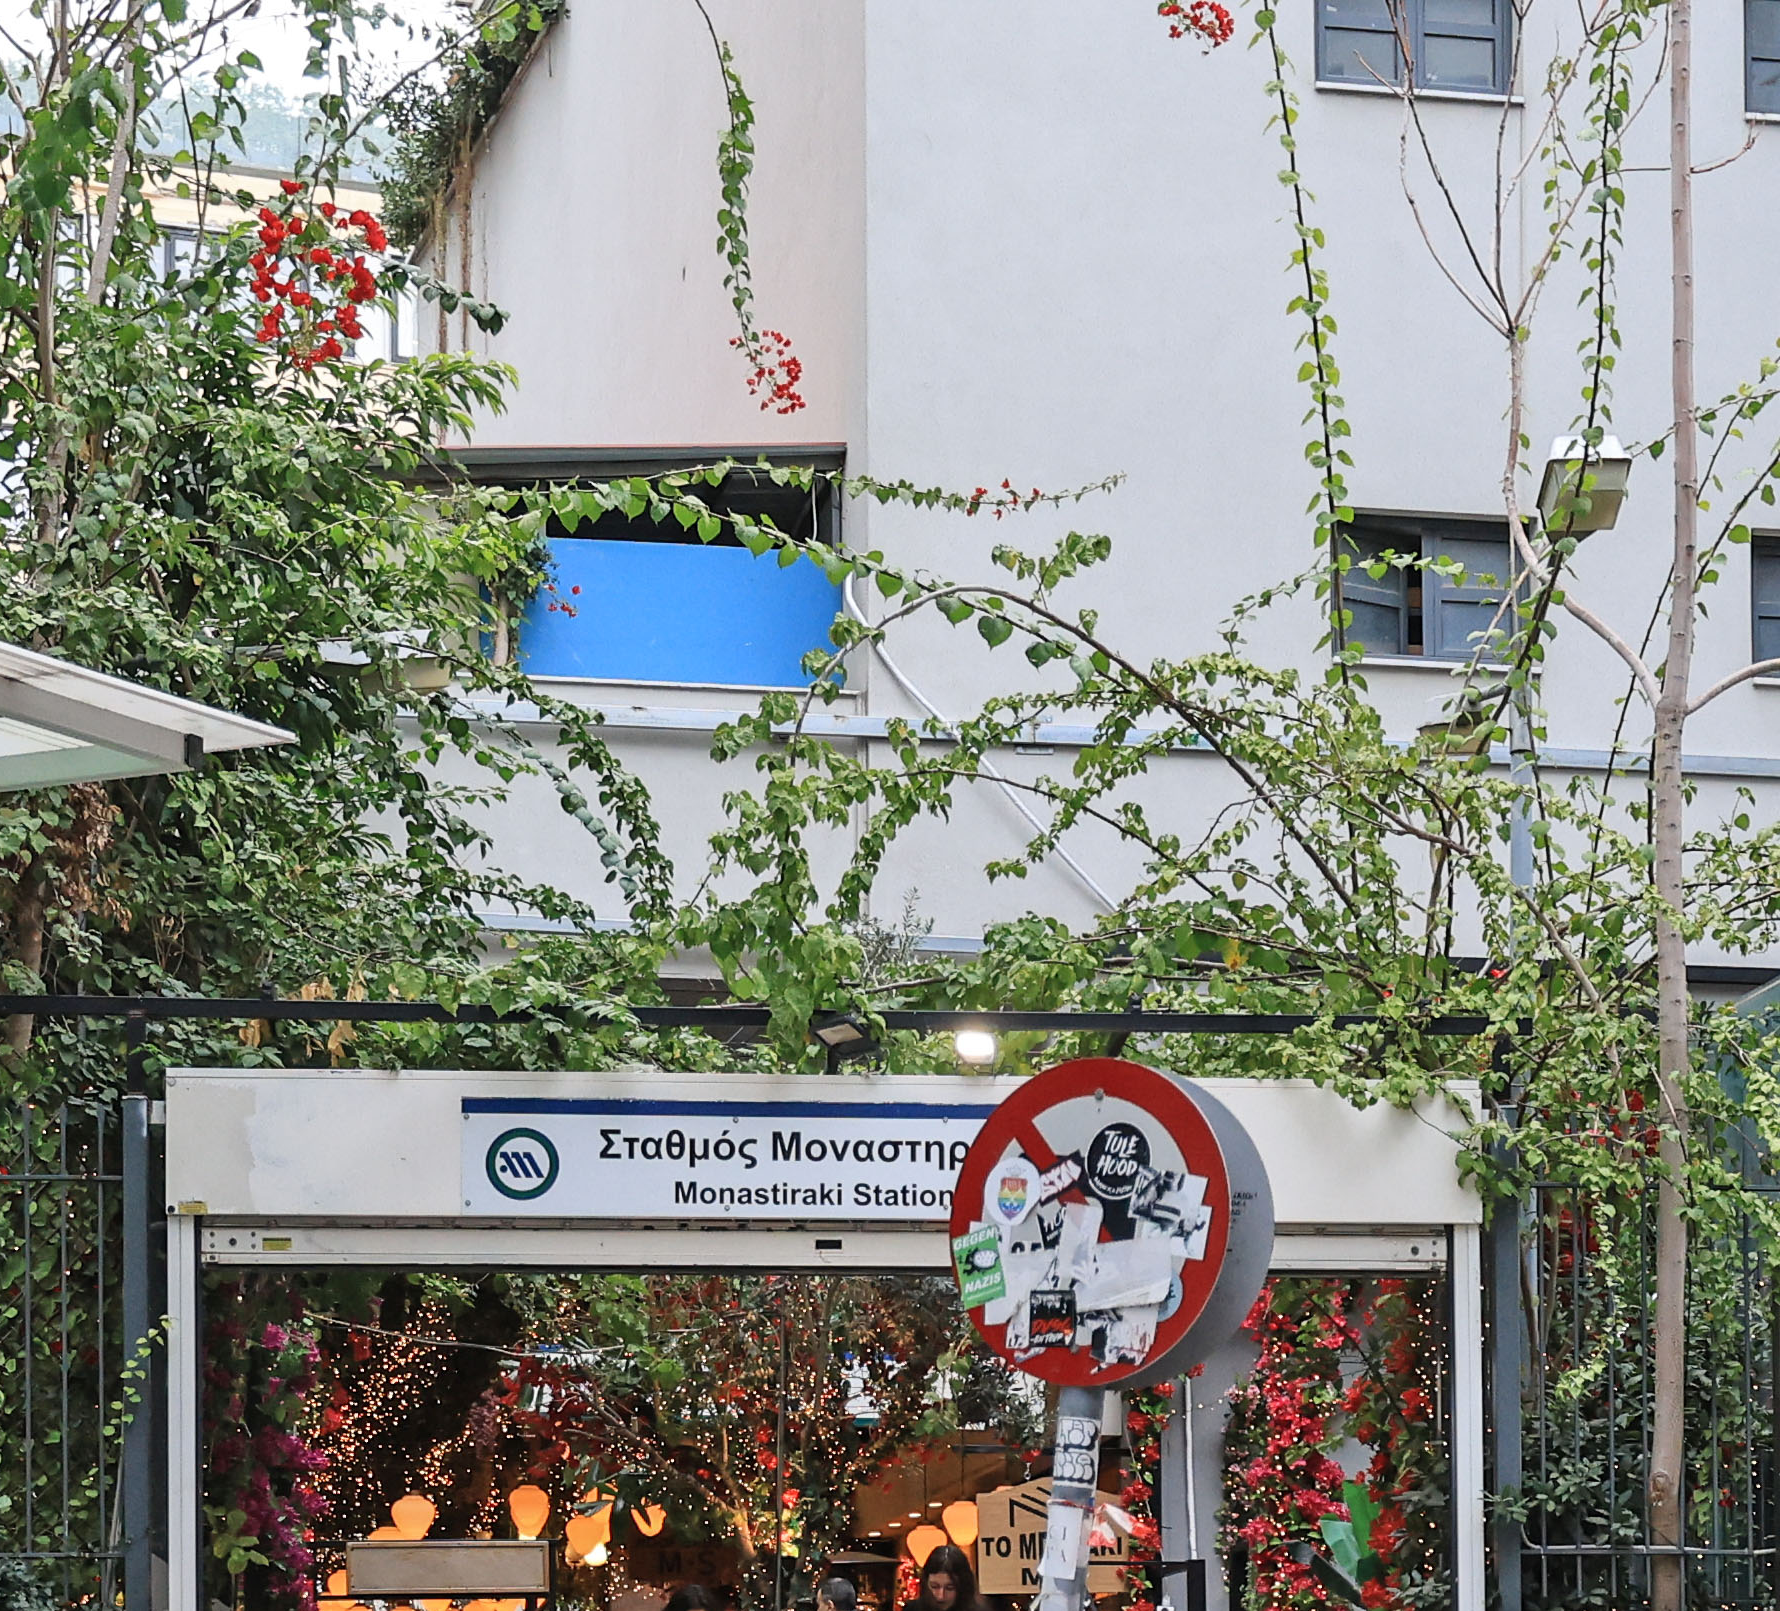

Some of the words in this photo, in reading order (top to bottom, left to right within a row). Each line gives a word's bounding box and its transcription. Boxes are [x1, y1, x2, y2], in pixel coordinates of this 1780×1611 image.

[599, 1128, 759, 1170] Σταθμός
[773, 1131, 973, 1171] Μοναστηρ
[674, 1180, 843, 1207] Monastiraki
[852, 1181, 955, 1208] Station
[964, 1271, 1001, 1294] NAZIS
